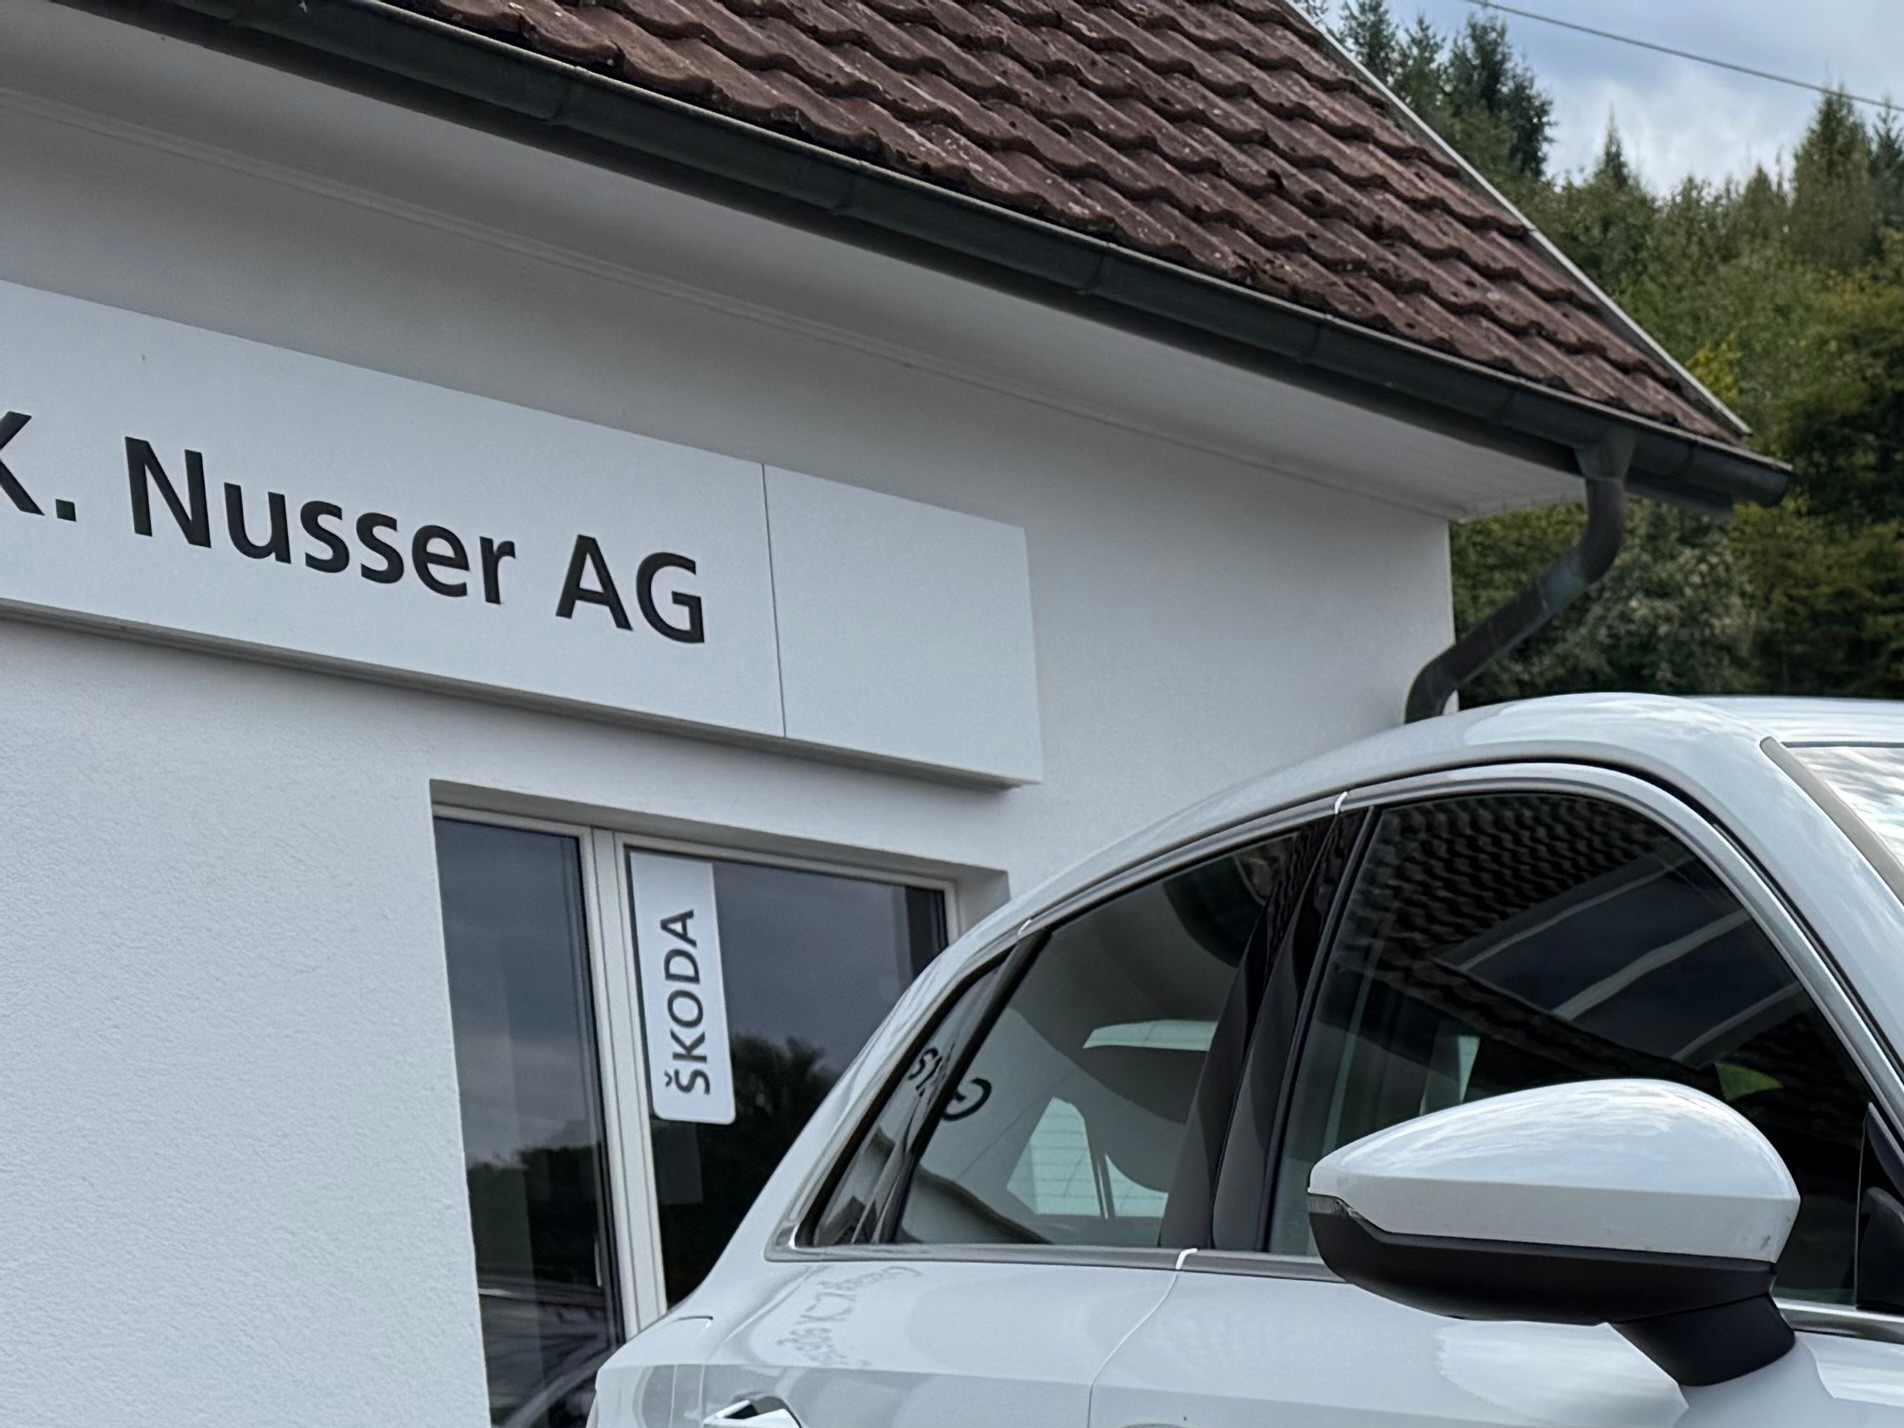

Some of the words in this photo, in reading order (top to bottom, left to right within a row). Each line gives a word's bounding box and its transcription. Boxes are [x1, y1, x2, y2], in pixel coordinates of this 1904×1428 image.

[124, 436, 516, 605] Nusser
[555, 533, 705, 644] AG
[660, 908, 710, 1095] ŠKODA
